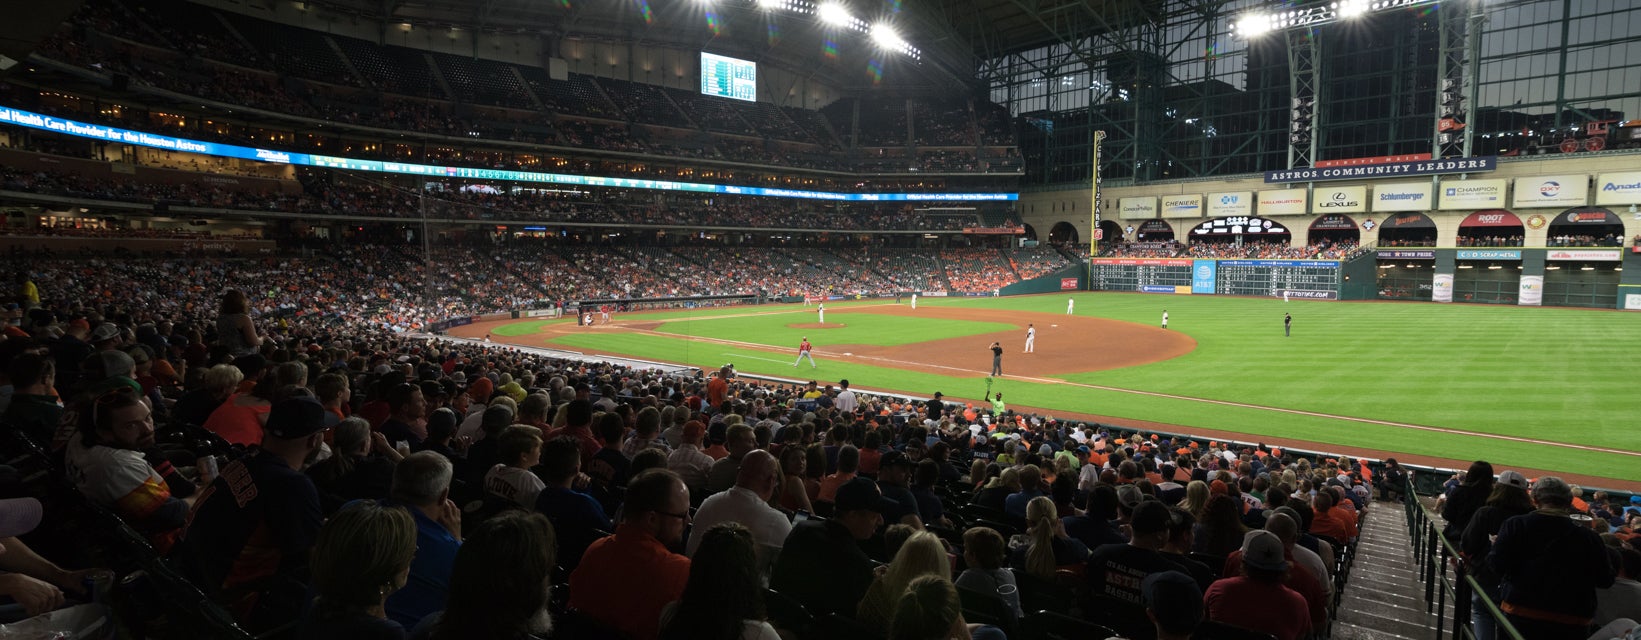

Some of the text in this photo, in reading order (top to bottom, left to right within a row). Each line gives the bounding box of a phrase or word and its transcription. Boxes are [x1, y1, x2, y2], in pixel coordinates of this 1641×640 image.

[11, 110, 44, 127] Health
[44, 117, 66, 131] Care
[66, 121, 107, 138] Provider
[107, 128, 122, 140] for
[123, 131, 139, 143] the
[140, 133, 175, 149] Houston
[176, 140, 206, 152] Astros
[1271, 159, 1488, 180] ASTROS COMMUNITY LEADERS
[1380, 192, 1425, 202] Schlumberger
[1165, 199, 1199, 207] CHENIERE
[1319, 200, 1359, 208] LEXUS
